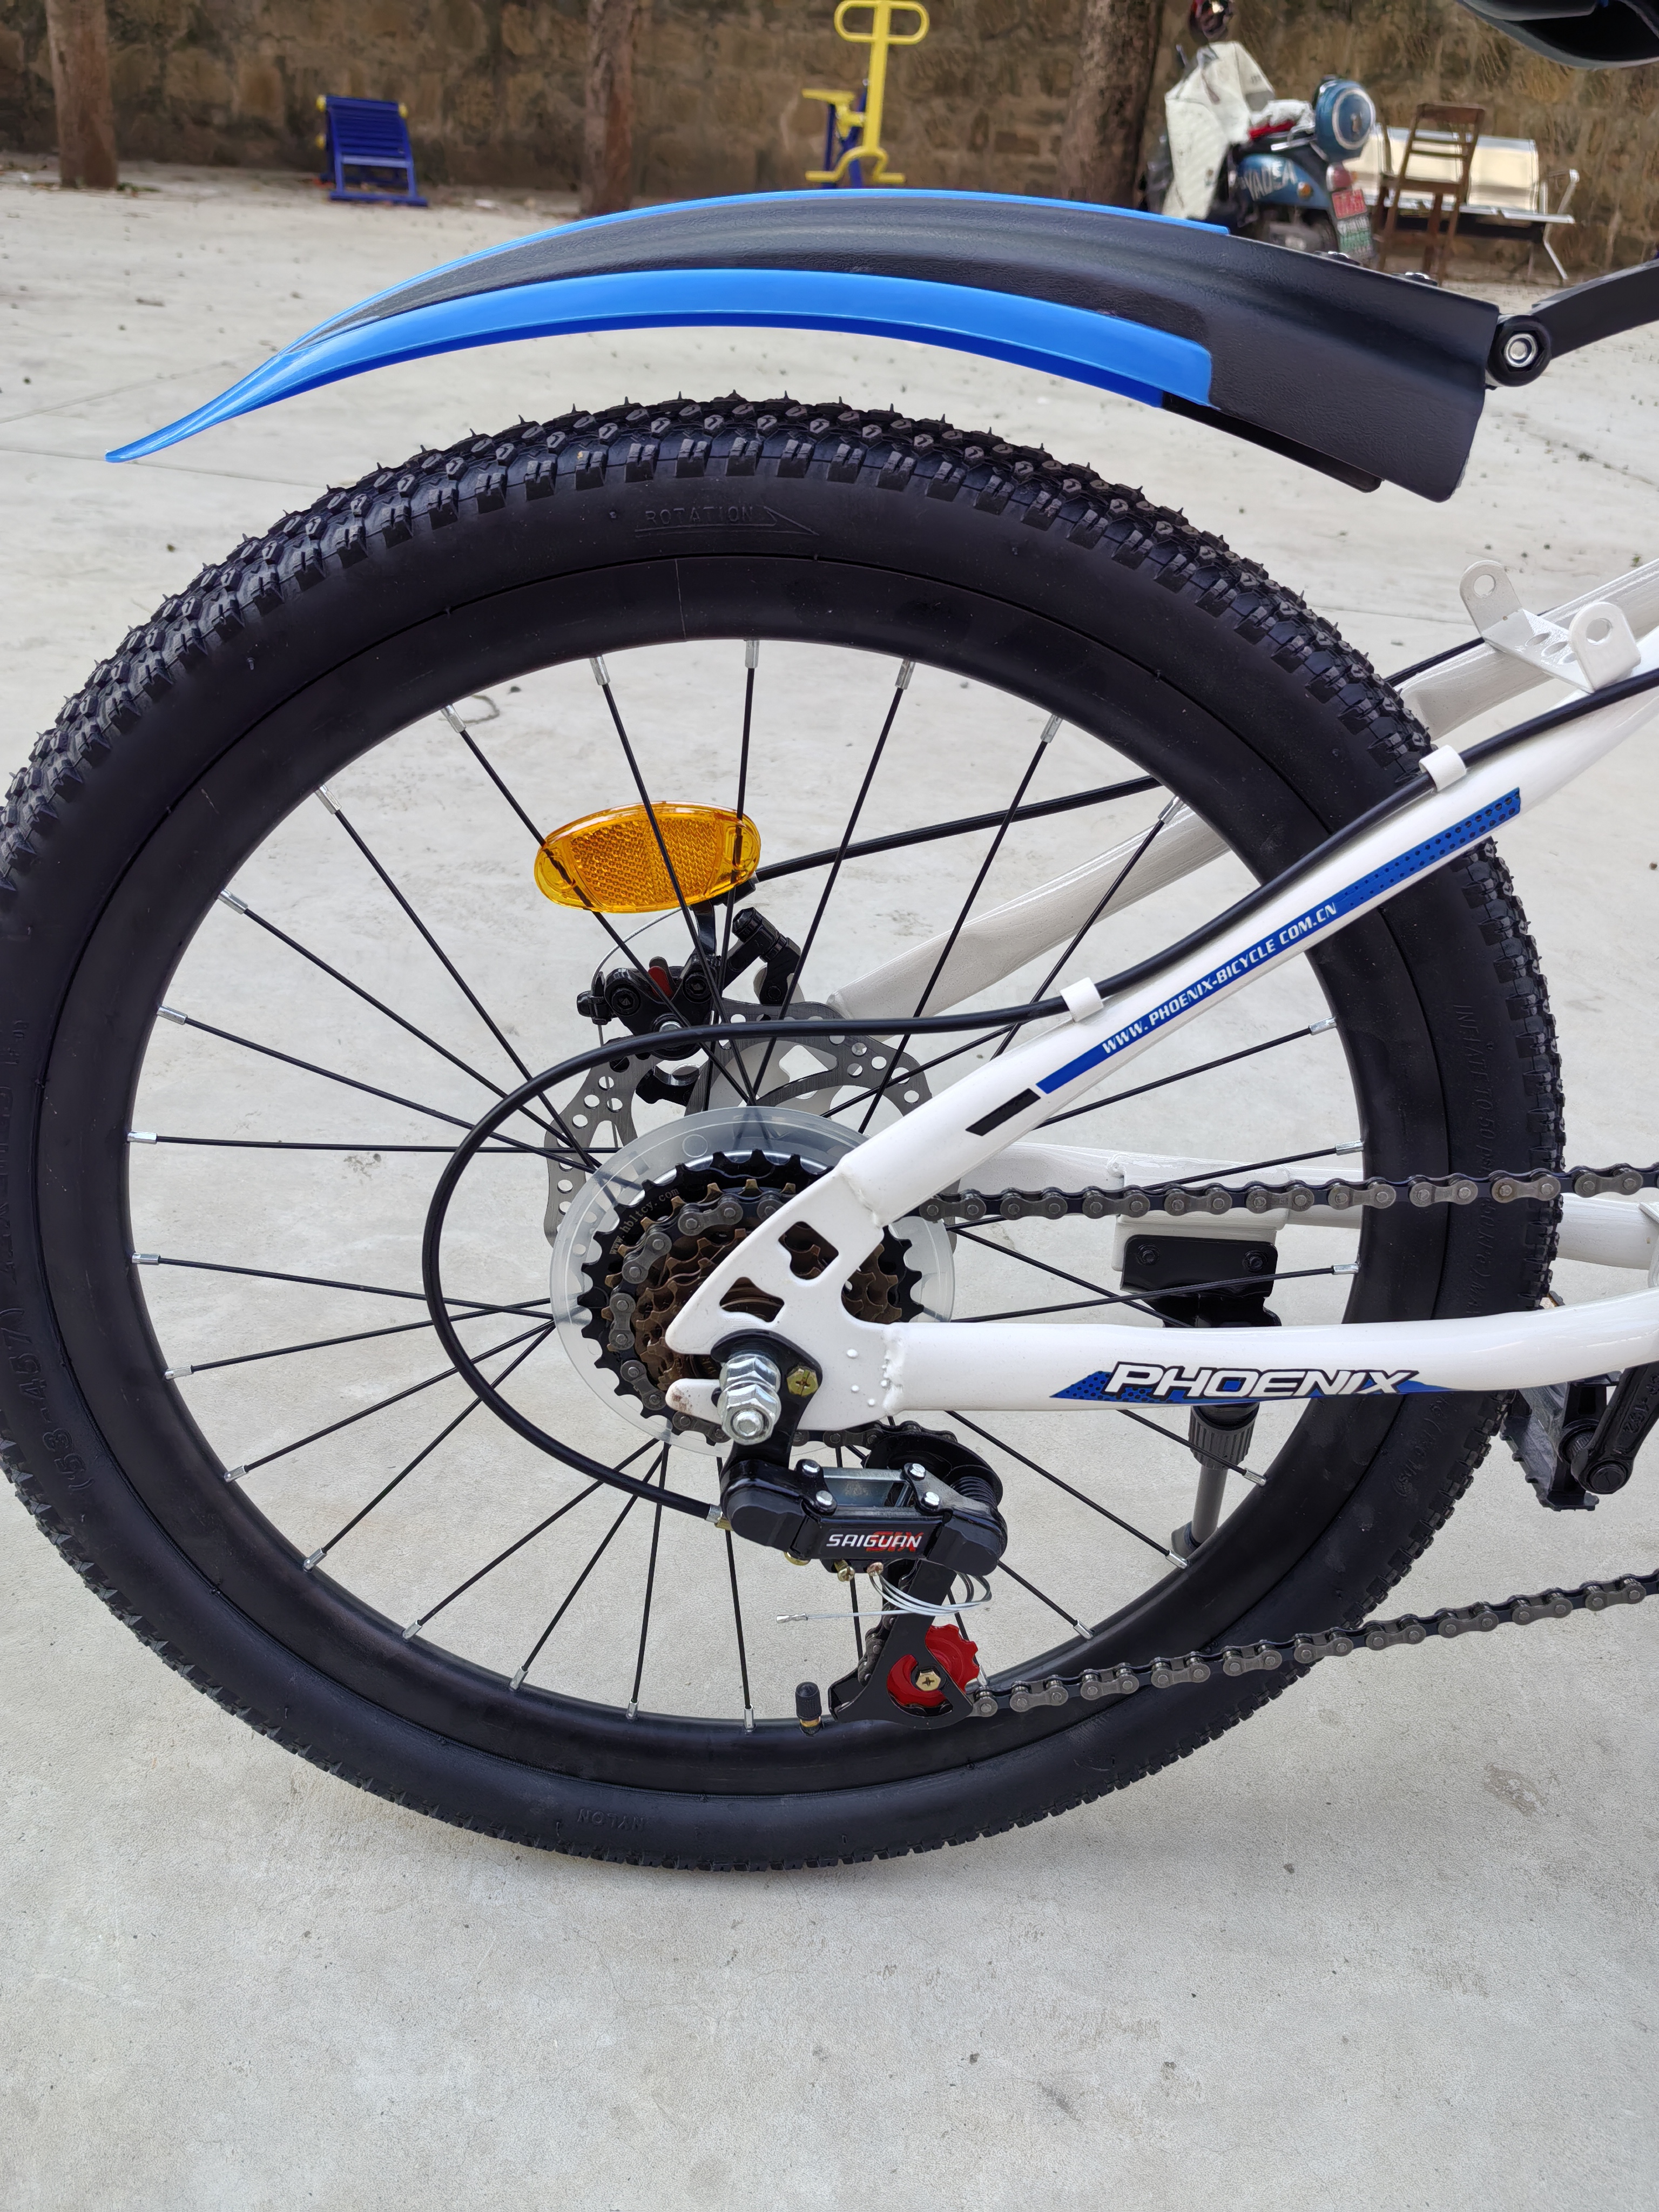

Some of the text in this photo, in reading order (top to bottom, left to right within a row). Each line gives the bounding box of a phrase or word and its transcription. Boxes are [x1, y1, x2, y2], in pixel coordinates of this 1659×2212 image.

[645, 504, 753, 524] ROTATION
[1104, 1361, 1420, 1398] PHOENIX
[826, 1534, 922, 1547] SAIGUAN
